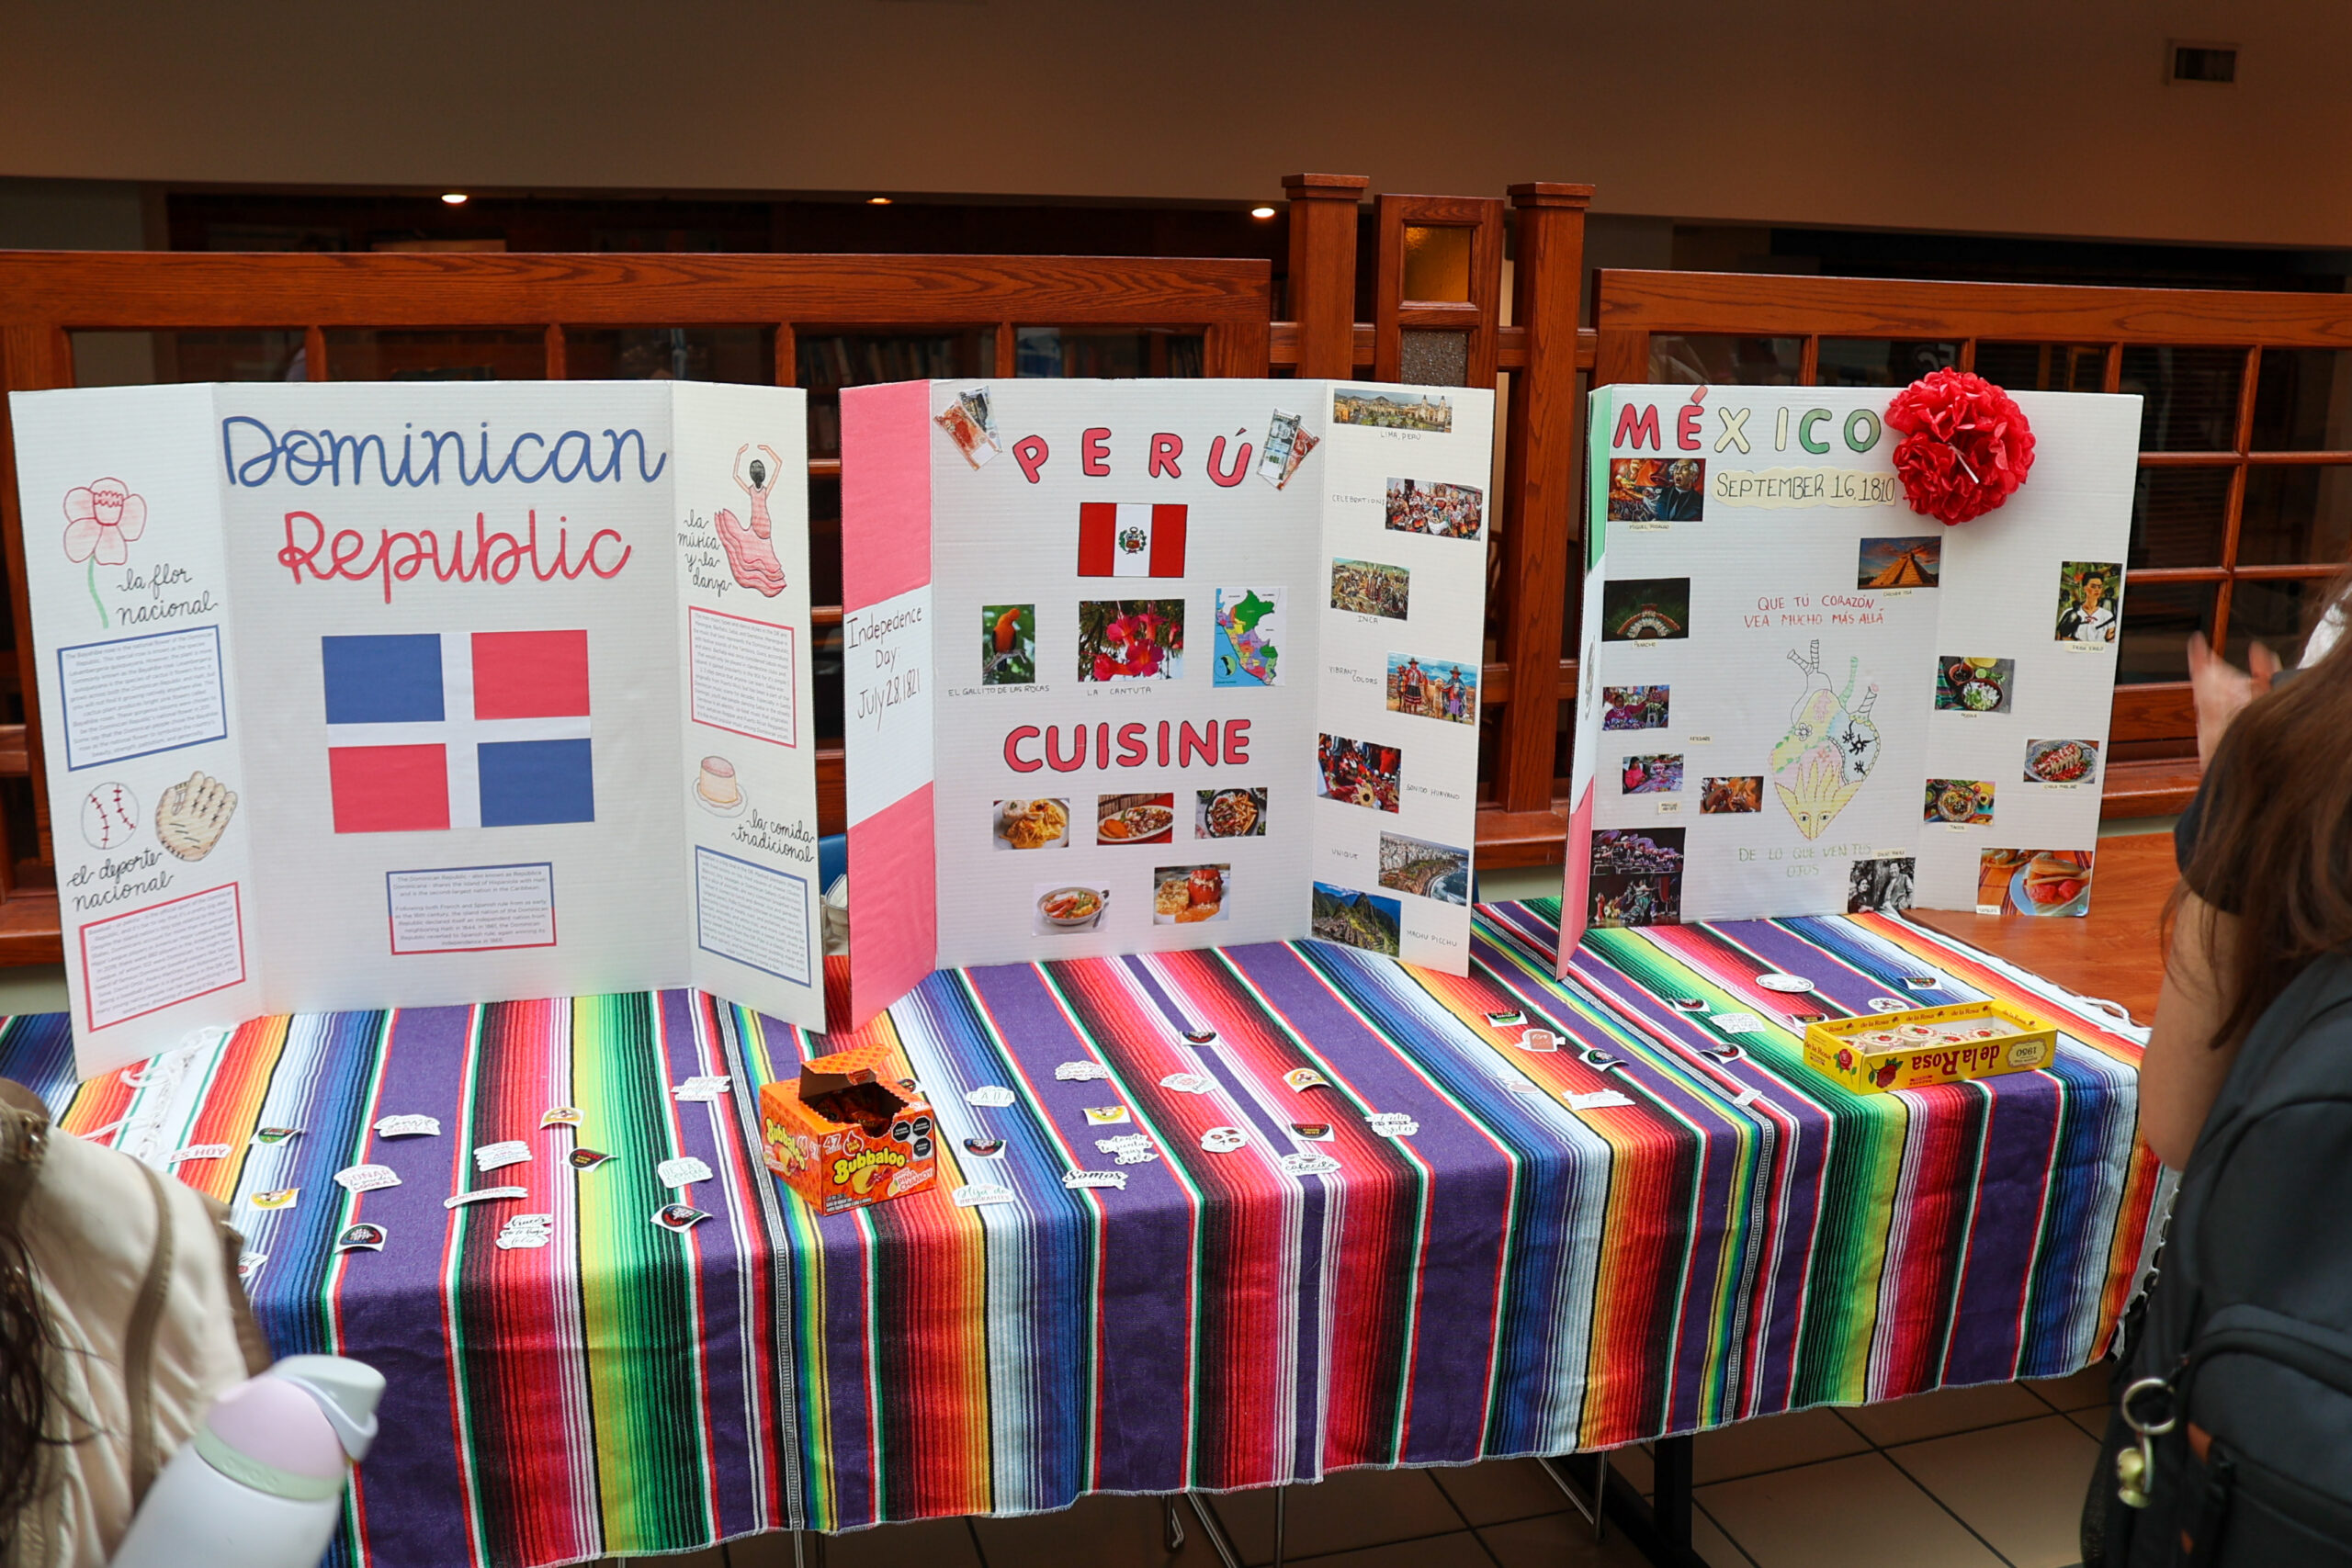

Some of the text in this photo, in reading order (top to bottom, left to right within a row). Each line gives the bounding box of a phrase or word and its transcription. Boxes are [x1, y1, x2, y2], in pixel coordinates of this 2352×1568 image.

[1613, 385, 1881, 455] MÉXICO
[222, 416, 667, 488] Dominican
[1012, 426, 1253, 488] PERÚ
[1716, 473, 1825, 501] SEPTEMBER
[684, 509, 709, 529] la
[677, 532, 720, 552] música
[277, 510, 632, 604] Republic
[684, 551, 720, 573] y la
[117, 563, 193, 599] la flor
[692, 568, 732, 598] danza
[118, 591, 219, 626] nacional
[1758, 596, 1785, 611] QUE
[1821, 593, 1875, 610] CORAZÓN
[1357, 615, 1379, 625] INCA
[1744, 614, 1770, 628] VEA
[1781, 613, 1823, 626] MUCHO
[1831, 610, 1855, 626] MÁS
[1329, 665, 1357, 677] VIBRANT
[962, 687, 997, 697] GALLITO
[1109, 686, 1153, 696] CANTUTA
[1003, 718, 1251, 773] CUISINE
[746, 808, 815, 843] la comida
[730, 824, 815, 863] tradicional
[1331, 848, 1360, 860] UNIQUE
[67, 847, 163, 888] el deporte
[73, 872, 175, 911] nacional
[1406, 930, 1458, 947] MACHU PICCHU
[1912, 1044, 2000, 1076] de la Rosa
[2016, 1044, 2038, 1057] 1950
[766, 1118, 806, 1171] Bubbaloo
[832, 1146, 906, 1185] Bubbaloo
[899, 1168, 934, 1192] CHAMOY
[1065, 1169, 1124, 1181] Somos
